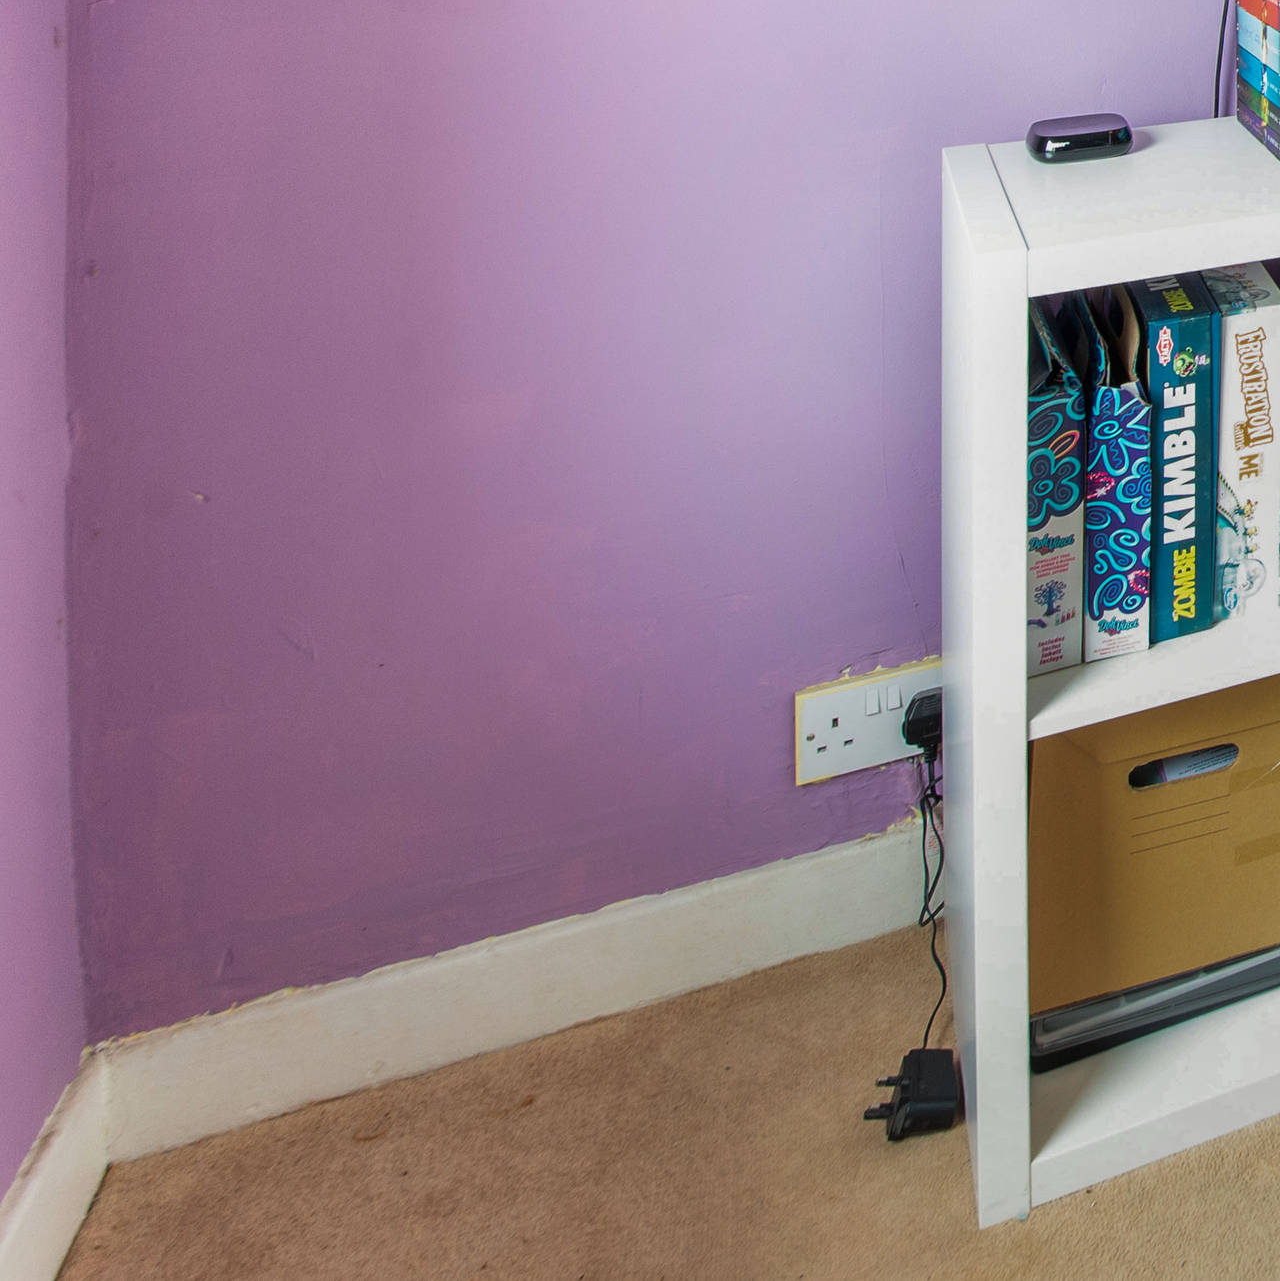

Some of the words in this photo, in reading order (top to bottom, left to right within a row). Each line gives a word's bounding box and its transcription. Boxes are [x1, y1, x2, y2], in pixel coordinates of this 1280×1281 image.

[1163, 383, 1197, 544] KIMBLE
[1239, 454, 1259, 481] ME
[1172, 545, 1197, 622] ZOMBIE
